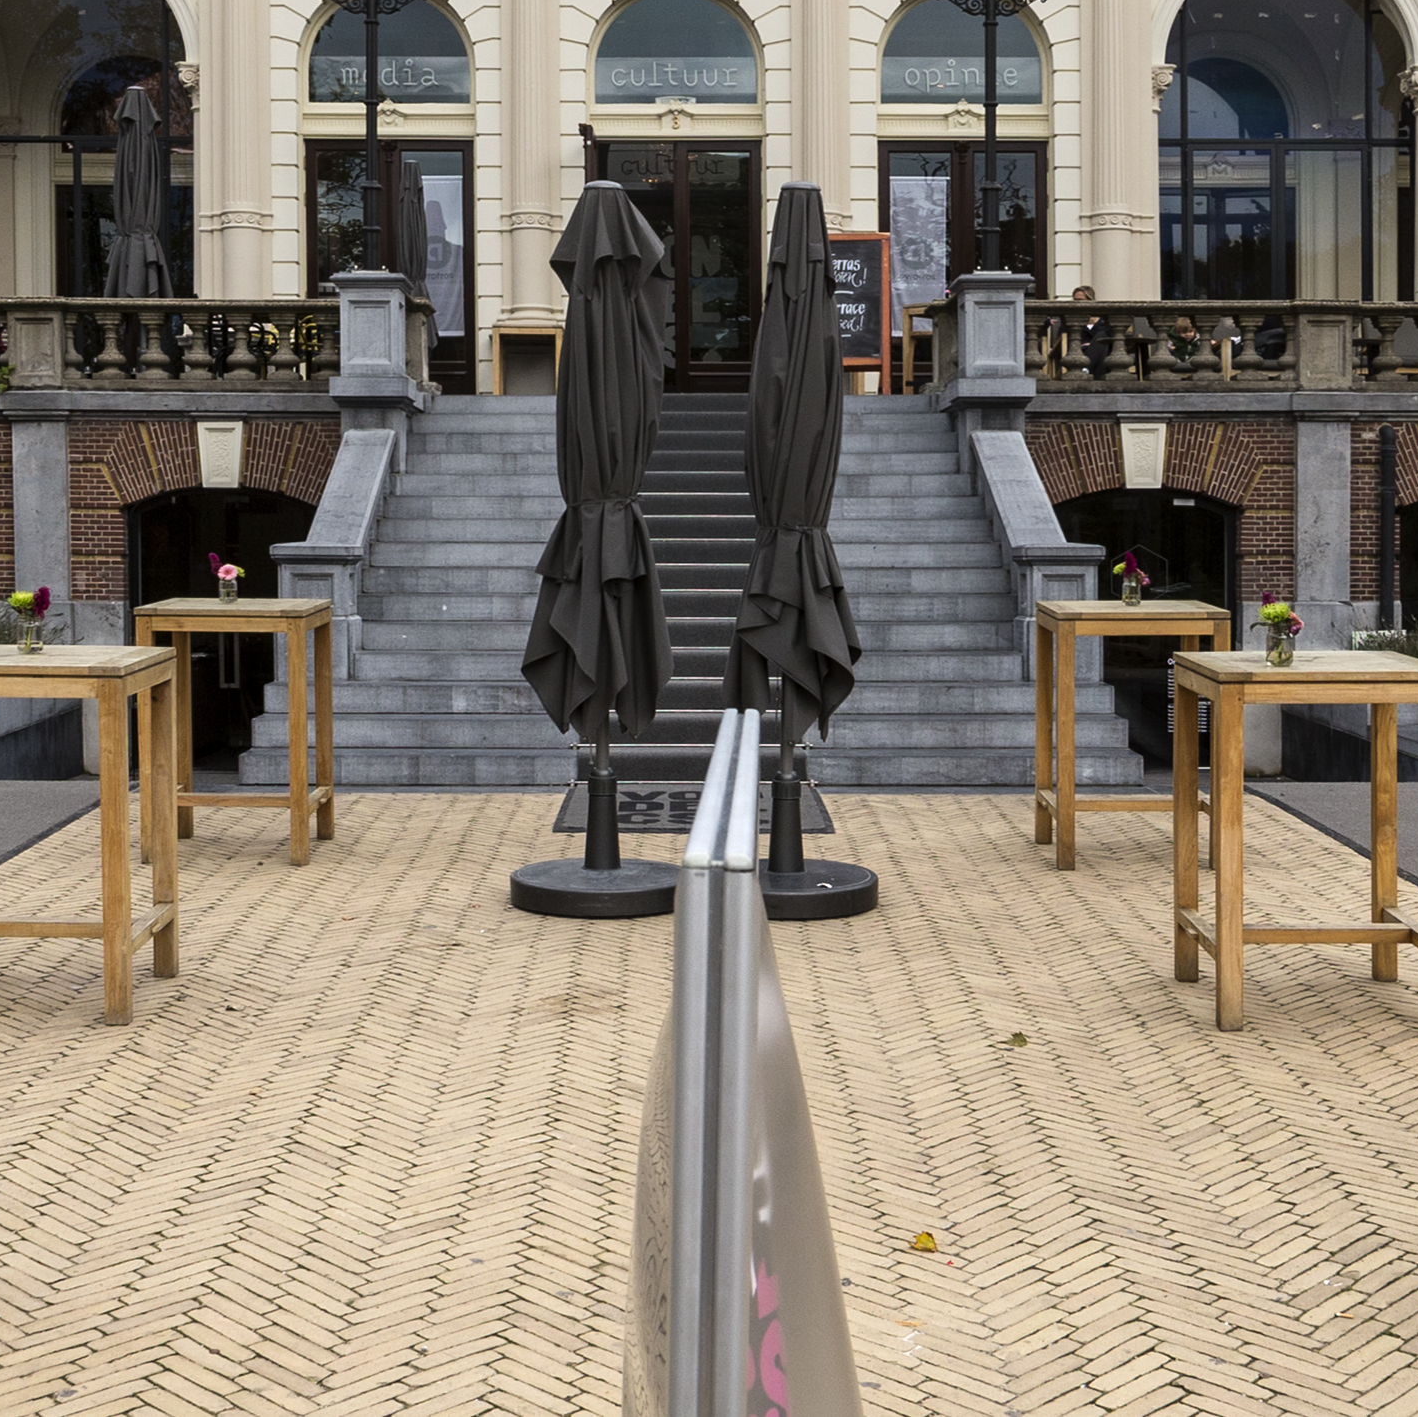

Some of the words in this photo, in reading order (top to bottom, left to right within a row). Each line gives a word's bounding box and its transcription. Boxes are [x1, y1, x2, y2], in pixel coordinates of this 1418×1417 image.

[340, 58, 439, 86] mdia
[611, 61, 738, 87] cultuur
[904, 58, 1018, 93] opine
[620, 153, 725, 176] cultur
[832, 258, 861, 271] erras
